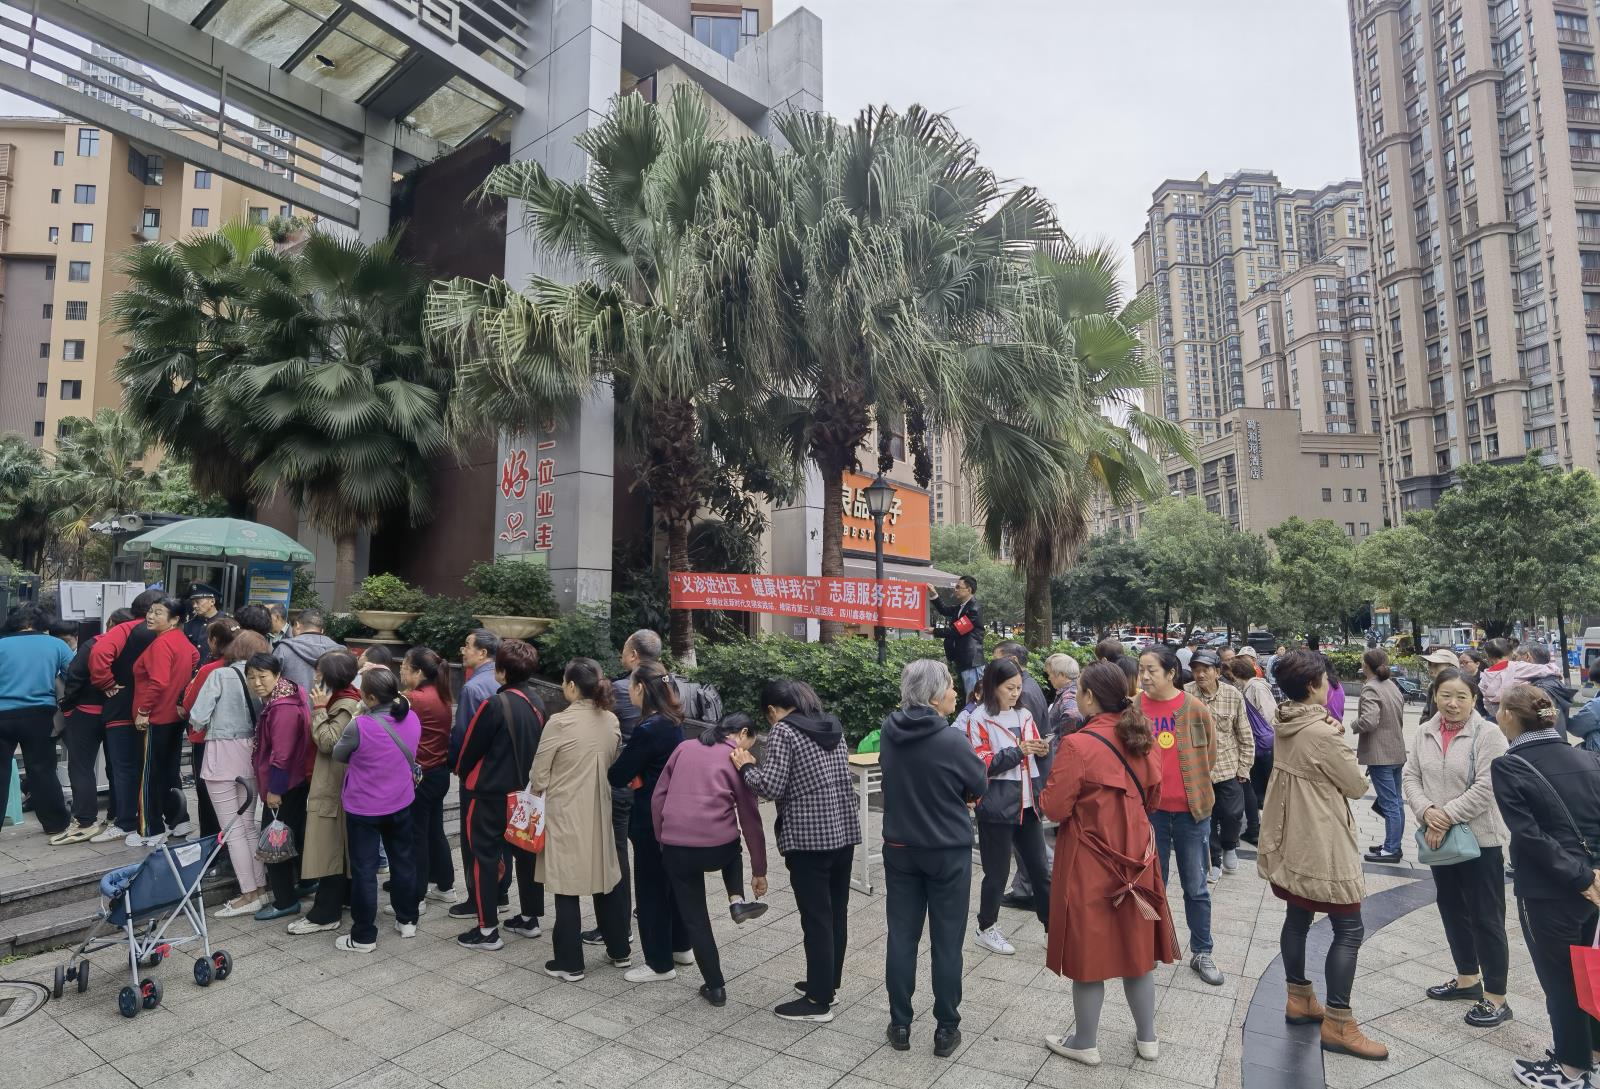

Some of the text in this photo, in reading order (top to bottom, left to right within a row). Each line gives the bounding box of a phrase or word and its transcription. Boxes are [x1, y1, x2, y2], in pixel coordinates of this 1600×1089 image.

[842, 483, 903, 525] 良品子
[843, 525, 896, 544] BESTRE
[828, 580, 921, 609] 志愿服务活动
